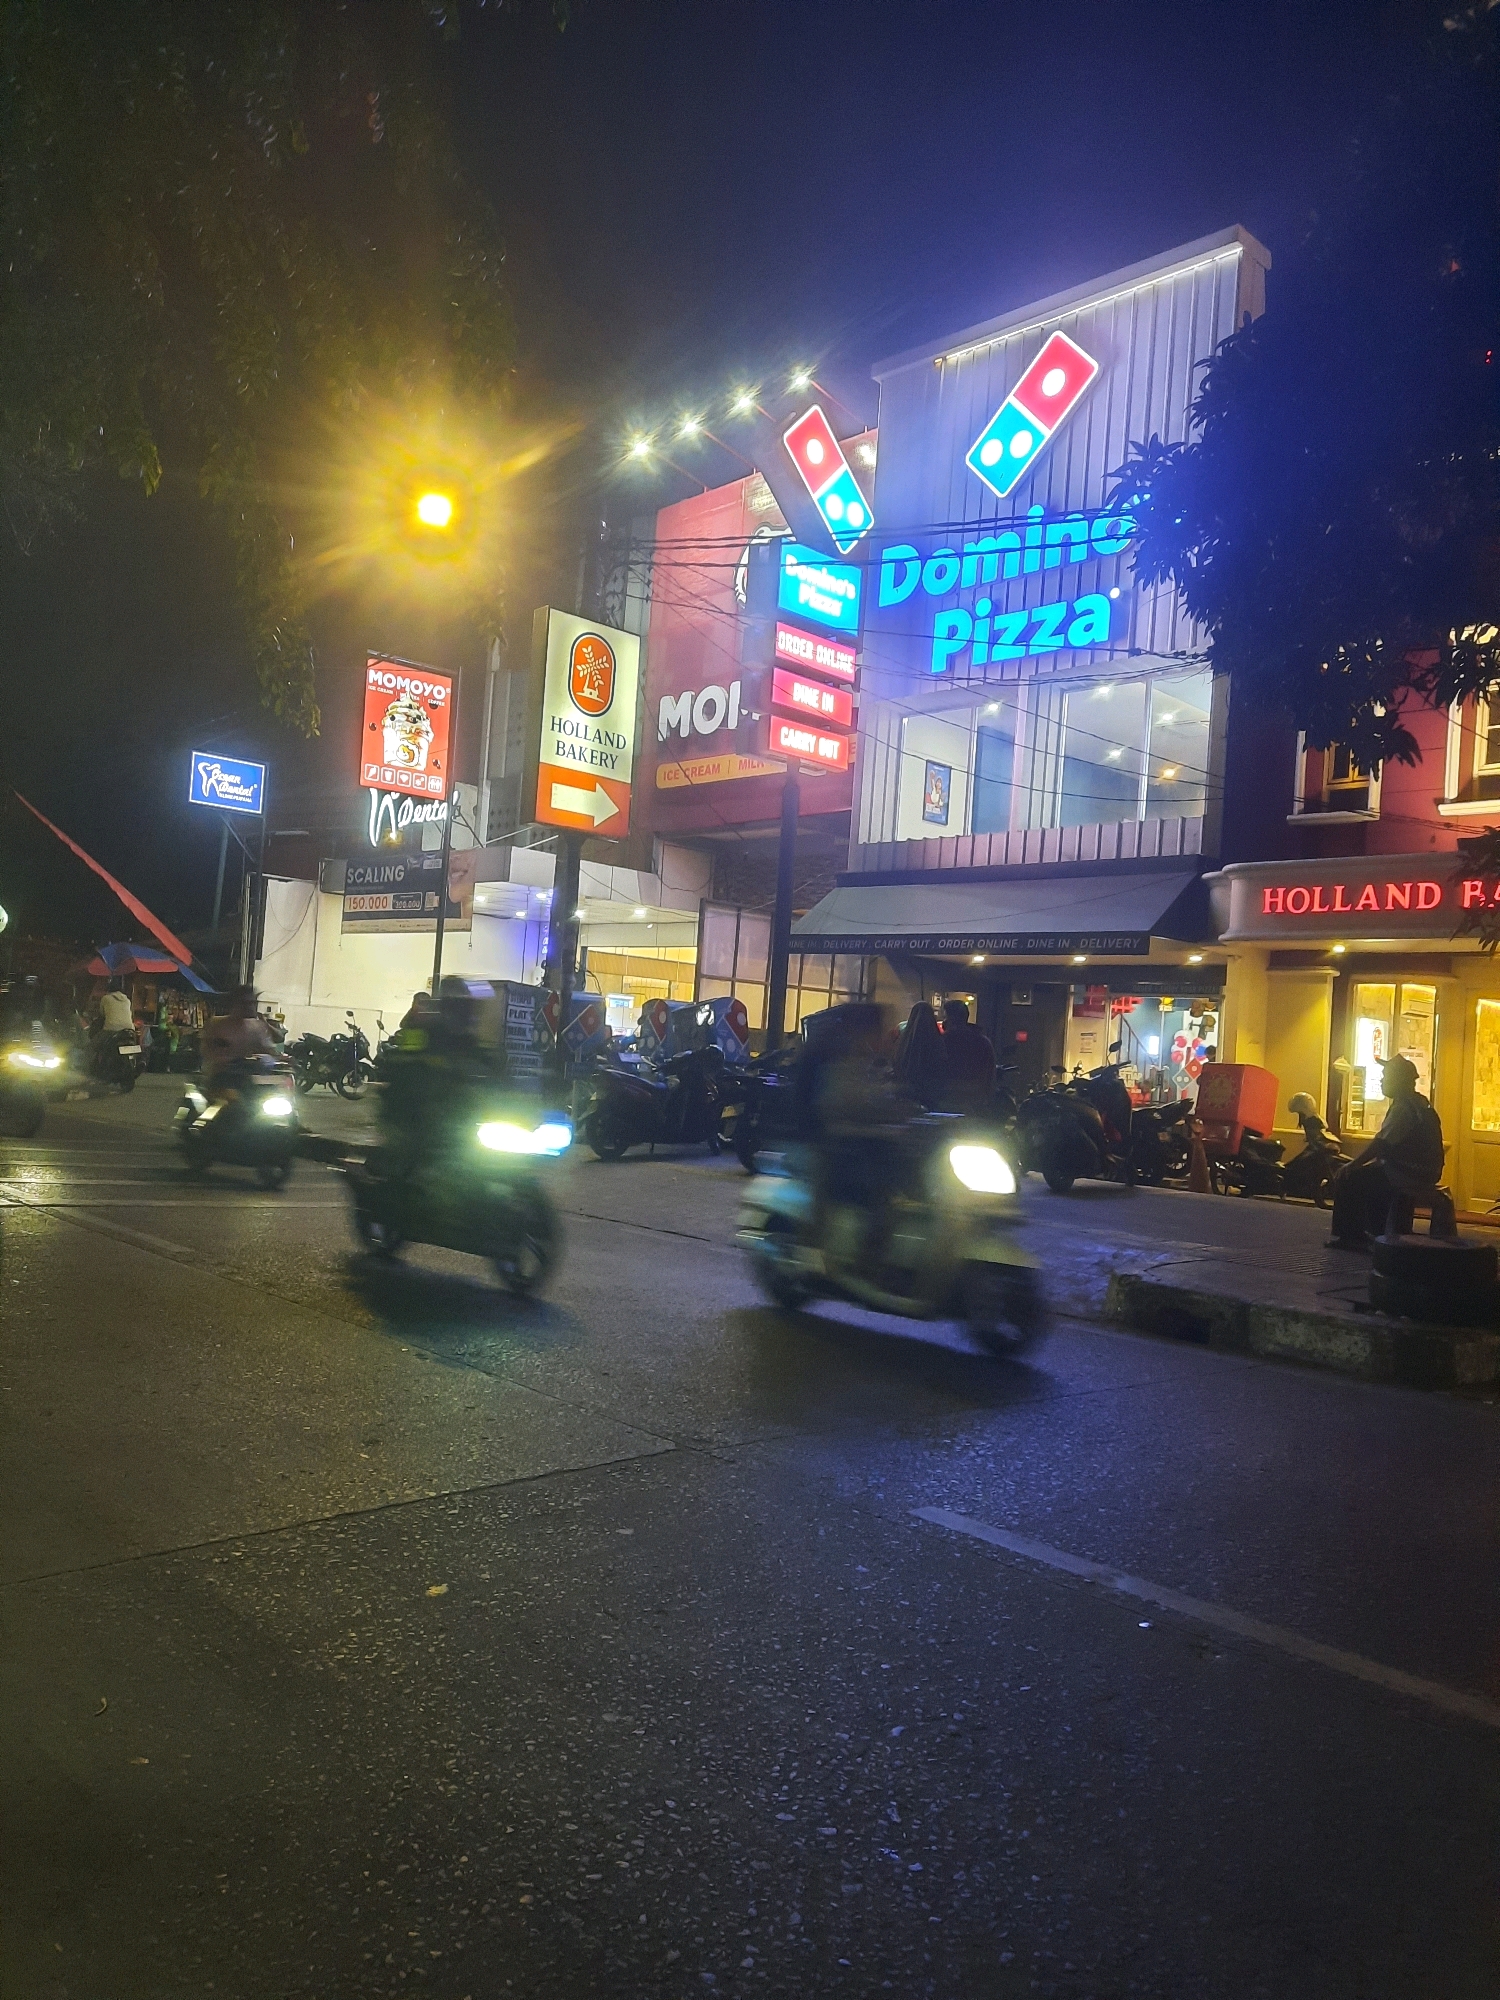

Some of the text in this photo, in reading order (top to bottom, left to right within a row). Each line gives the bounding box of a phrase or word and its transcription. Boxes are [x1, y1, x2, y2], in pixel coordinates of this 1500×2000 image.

[879, 504, 1138, 608] Domino
[786, 553, 856, 600] Domino's
[799, 583, 843, 618] Pizza
[931, 593, 1111, 674] Pizza
[777, 631, 854, 674] ORDER ONLINE
[368, 669, 446, 700] MOMOYO
[793, 682, 835, 713] DINE IN
[550, 715, 627, 750] HOLLAND
[780, 726, 817, 754] CARRY
[818, 738, 840, 761] OUT
[555, 740, 619, 770] BAKERY
[663, 770, 680, 781] ICE
[685, 764, 721, 779] CREAM
[346, 864, 405, 884] SCALING
[348, 895, 388, 910] 150.000
[1262, 882, 1442, 914] HOLLAND
[823, 940, 867, 949] DELIVERY
[874, 939, 906, 949] CARRY
[909, 939, 931, 949] OUT
[938, 938, 975, 949] ORDER
[977, 938, 1019, 949] ONLINE
[1027, 938, 1055, 949] DINE
[1058, 938, 1071, 949] IN
[1080, 938, 1141, 949] DELIVERY
